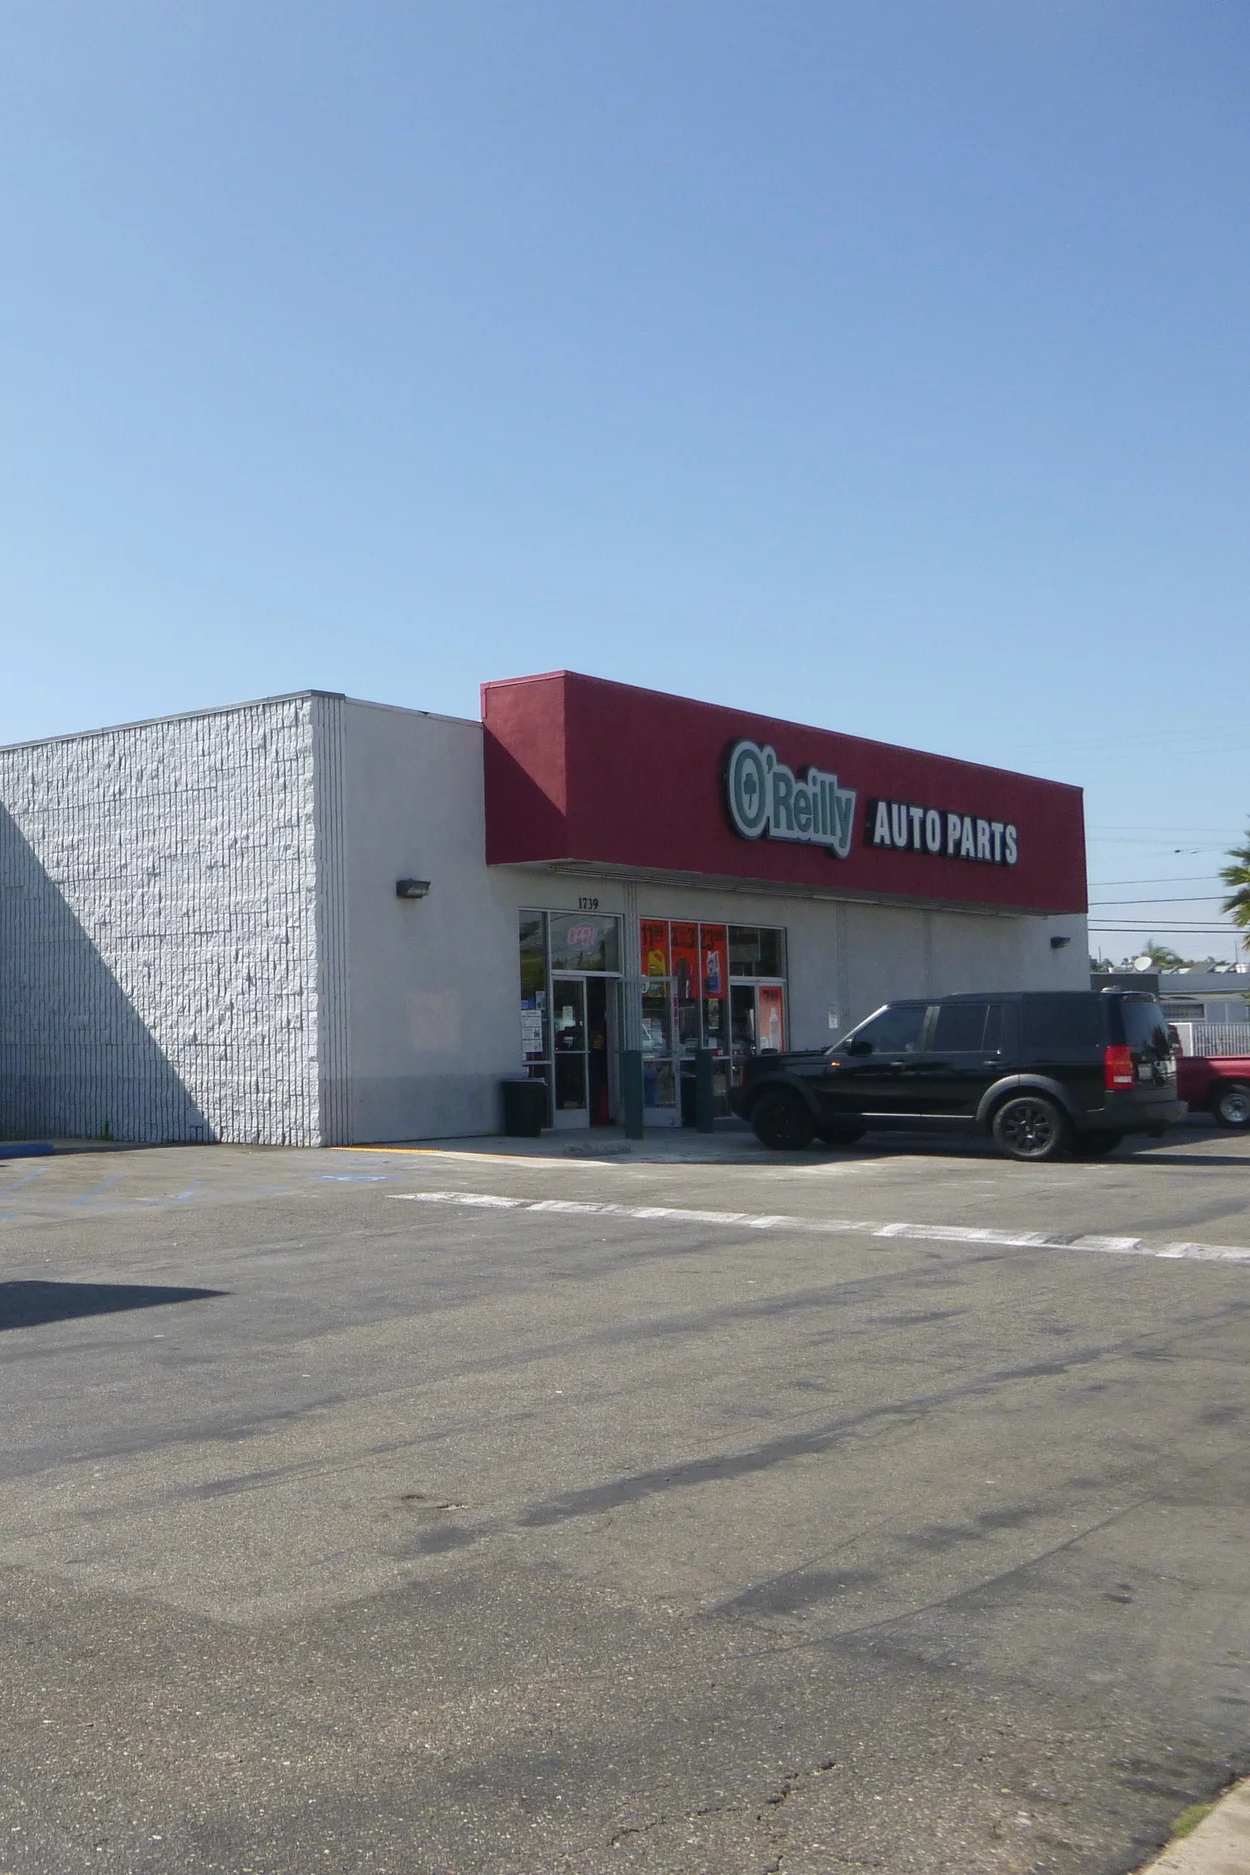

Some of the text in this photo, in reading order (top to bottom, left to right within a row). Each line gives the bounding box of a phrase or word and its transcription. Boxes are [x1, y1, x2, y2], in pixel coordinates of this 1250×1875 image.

[730, 741, 1018, 864] O'Reilly AUTO PARTS
[578, 897, 599, 910] 1739
